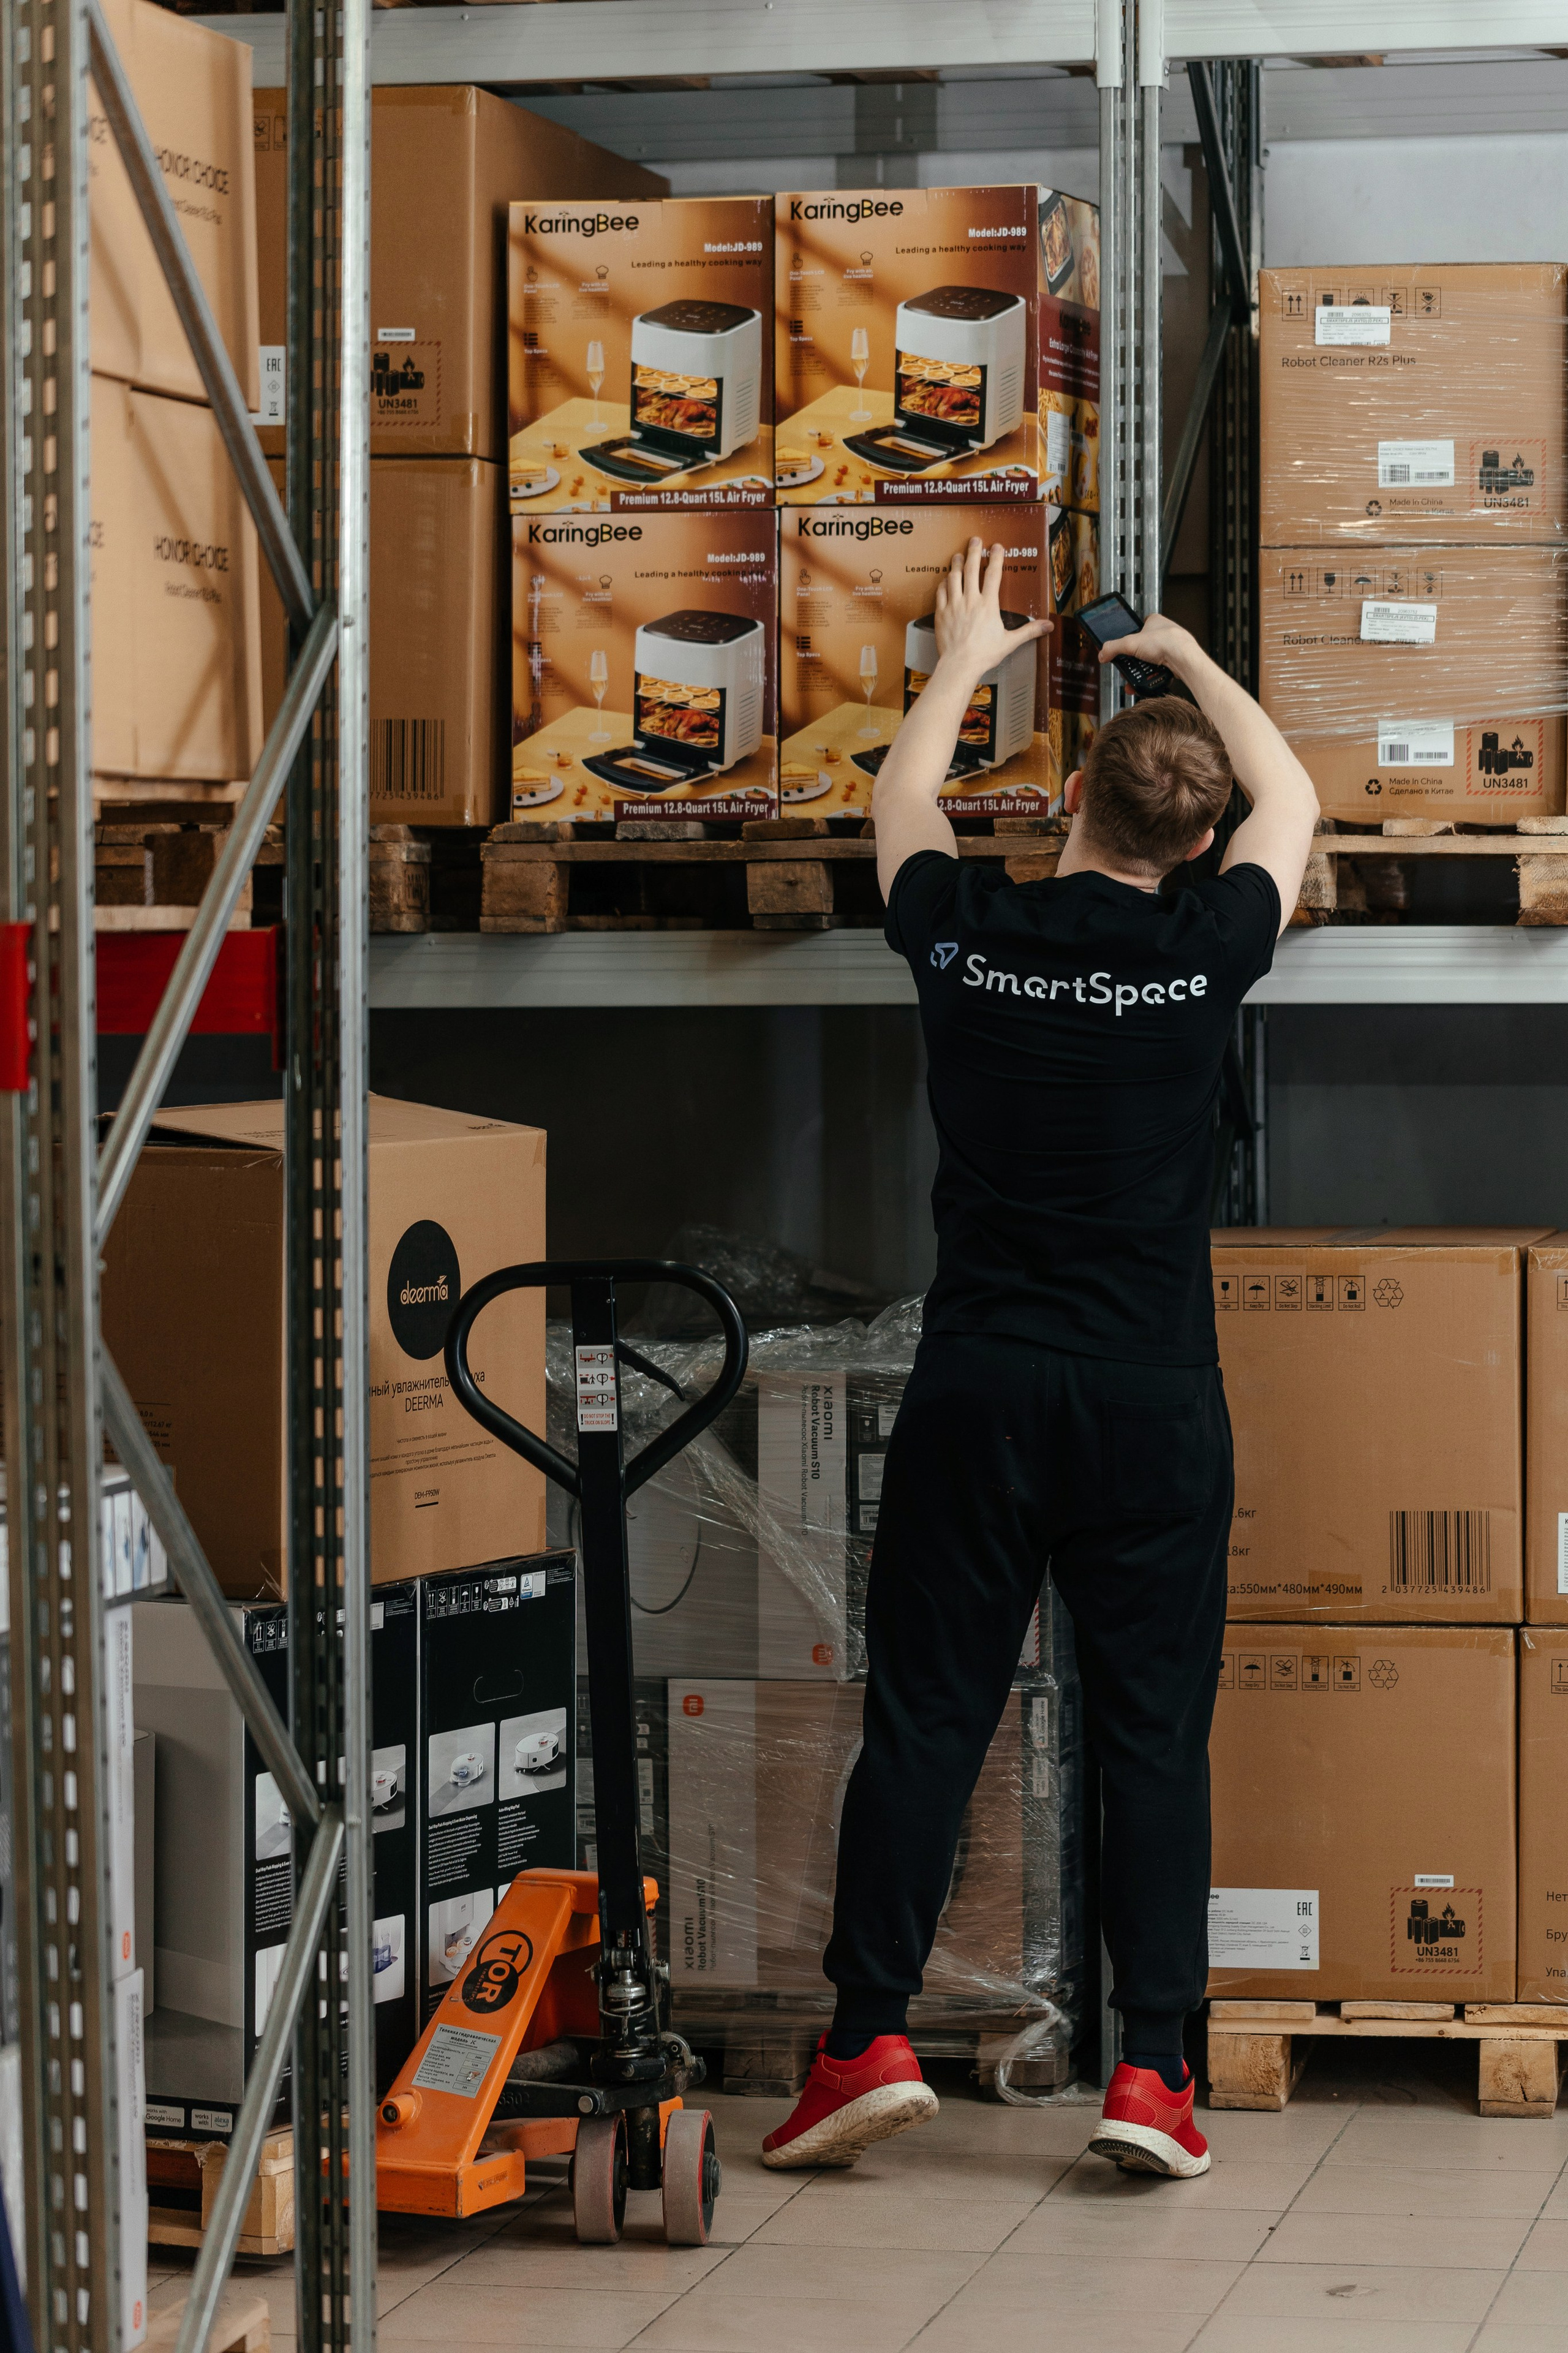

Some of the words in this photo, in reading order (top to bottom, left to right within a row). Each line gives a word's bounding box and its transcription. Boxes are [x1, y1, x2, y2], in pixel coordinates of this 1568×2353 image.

[790, 197, 903, 223] KaringBee
[525, 212, 639, 237] KaringBee
[968, 227, 1027, 238] Model:JD-989
[704, 243, 763, 252] Model:JD-989
[895, 246, 929, 255] Leading
[939, 244, 970, 254] healthy
[973, 244, 1006, 254] cooking
[1009, 244, 1027, 252] way
[631, 260, 665, 270] Leading
[675, 259, 706, 269] healthy
[709, 259, 744, 268] cooking
[1282, 357, 1316, 368] Robot
[1320, 356, 1365, 366] Cleaner
[1368, 356, 1389, 365] R2s
[1392, 355, 1416, 365] Plus
[379, 399, 418, 409] UN3481
[884, 482, 922, 494] Premium
[924, 481, 971, 494] 12.8-Quart
[973, 480, 989, 493] 15L
[990, 480, 1003, 493] Air
[1005, 480, 1029, 495] Fryer
[619, 492, 658, 505] Premium
[660, 491, 707, 504] 12.8-Quart
[709, 491, 725, 503] 15L
[727, 491, 740, 503] Air
[742, 491, 766, 505] Fryer
[1484, 497, 1529, 508] UN3481
[529, 521, 643, 546] KaringBee
[798, 515, 913, 540] KaringBee
[707, 553, 765, 563] Model:JD-989
[1283, 635, 1317, 645] Robot
[1321, 635, 1365, 645] Cleaner
[1483, 778, 1528, 788] UN3481
[623, 803, 662, 814] Premium
[664, 802, 710, 814] 12.8-Quart
[712, 802, 728, 814] 15L
[730, 802, 743, 813] Air
[745, 801, 768, 815] Fryer
[937, 799, 981, 811] 2.8-Quart
[982, 799, 999, 810] 15L
[1001, 799, 1014, 810] Air
[1016, 798, 1039, 814] Fryer
[962, 954, 1207, 1016] SmartSpace
[401, 1279, 448, 1305] deerma
[369, 1381, 390, 1397] ный
[391, 1377, 450, 1399] увлажнитель
[405, 1394, 443, 1413] DEERMA
[812, 1385, 820, 1416] Robot
[811, 1417, 821, 1460] Vacuum
[811, 1462, 821, 1479] S10
[1232, 1508, 1257, 1519] .6кг
[1297, 1902, 1313, 1916] EAC
[696, 1898, 706, 1939] Vacuum
[697, 1941, 706, 1971] Robot
[1417, 1946, 1458, 1957] UN3481
[476, 1944, 522, 2003] TOR
[458, 2031, 496, 2044] гидравлическая
[146, 2113, 166, 2123] Google
[214, 2115, 229, 2124] alexa
